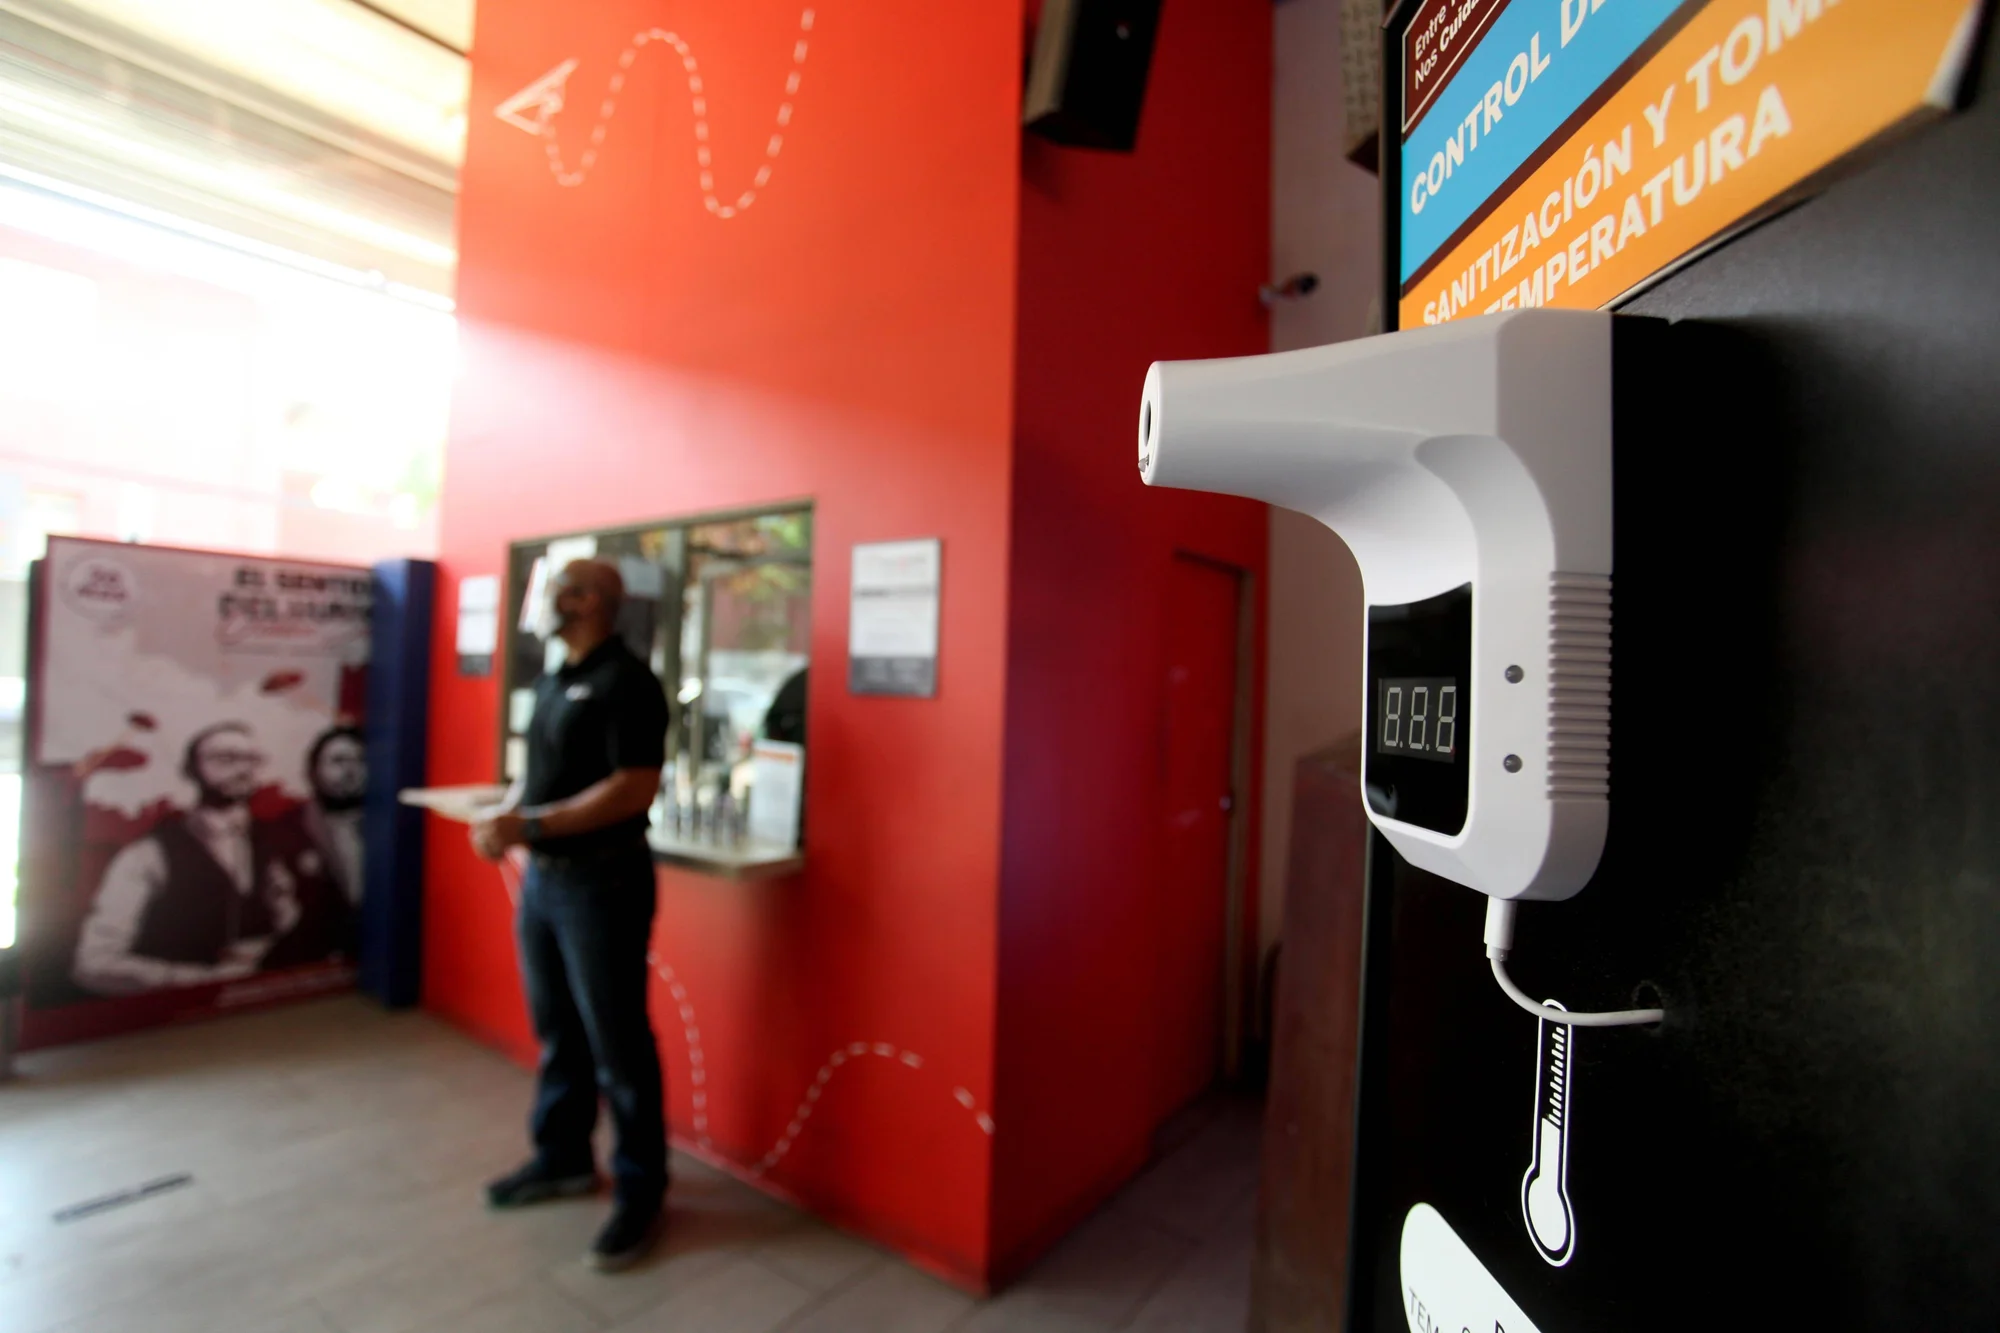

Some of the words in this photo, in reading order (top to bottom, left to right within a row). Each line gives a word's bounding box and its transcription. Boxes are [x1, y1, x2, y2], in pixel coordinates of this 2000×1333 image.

[1411, 31, 1551, 214] CONTROL
[1561, 0, 1607, 49] D
[1415, 5, 1446, 60] Entre
[1415, 48, 1438, 90] Nos
[1423, 124, 1633, 325] SANITIZACIÓN
[1643, 84, 1676, 149] Y
[1686, 0, 1841, 113] TOM
[1484, 84, 1791, 315] MPERATURA
